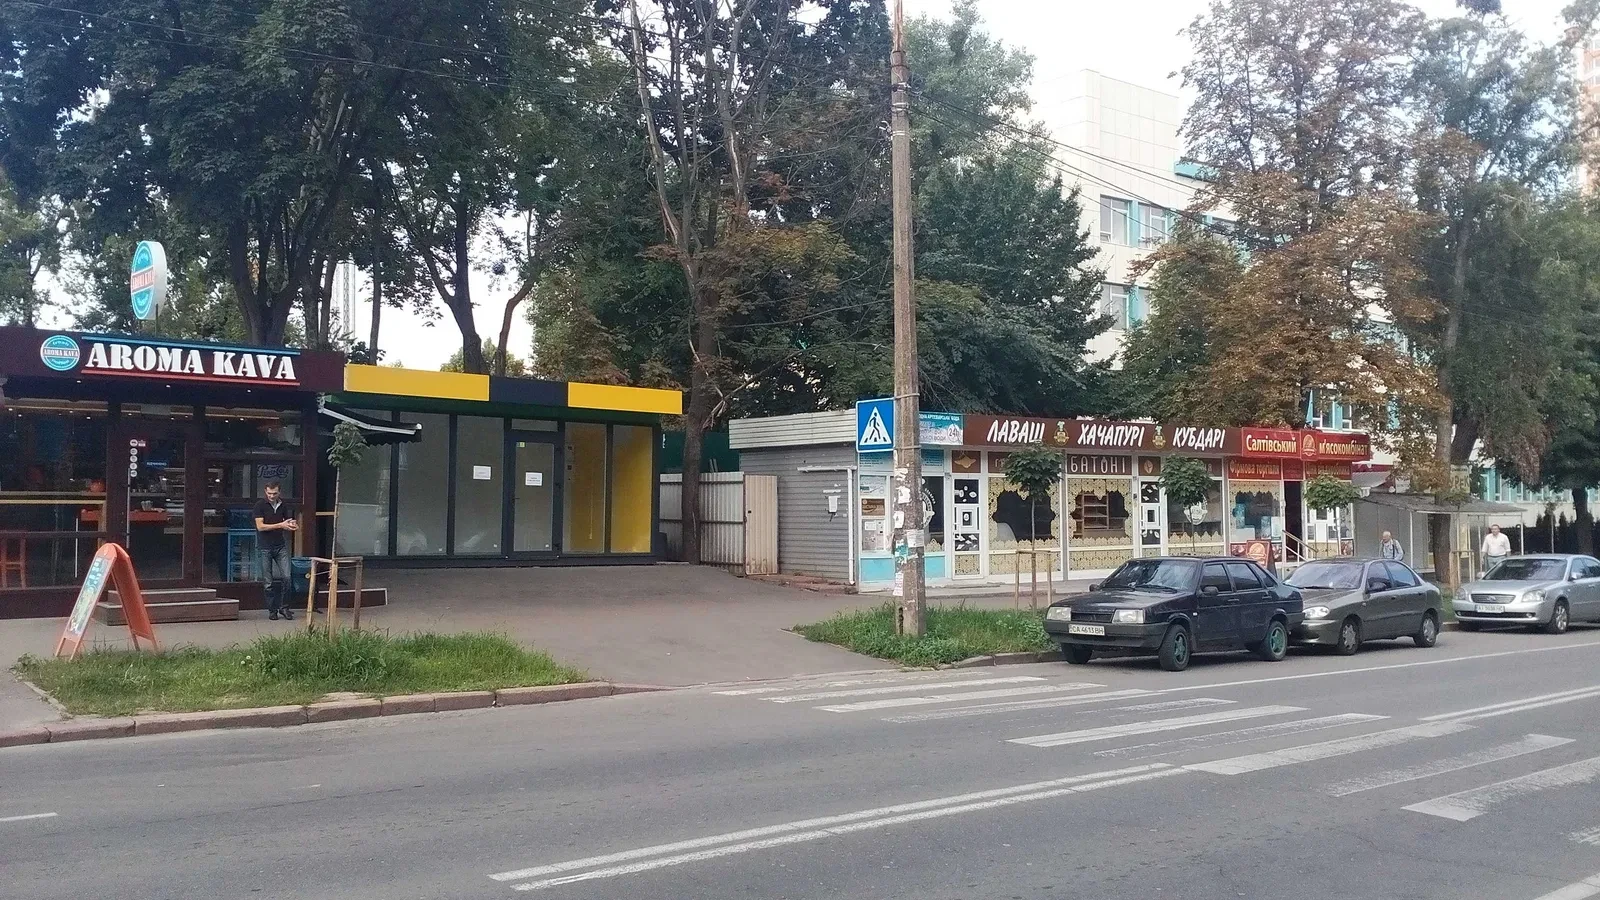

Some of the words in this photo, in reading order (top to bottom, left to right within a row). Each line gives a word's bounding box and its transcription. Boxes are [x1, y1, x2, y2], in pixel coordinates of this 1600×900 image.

[85, 342, 205, 374] AROMA
[213, 351, 297, 379] KAVA
[986, 419, 1046, 444] ЛАВАШ
[1077, 423, 1144, 447] ХАЧАПУРІ
[1172, 426, 1226, 450] КУБДАРІ
[1246, 434, 1297, 453] Салтівський
[1070, 455, 1126, 474] БАТОНІ
[1229, 459, 1255, 477] Фірмова
